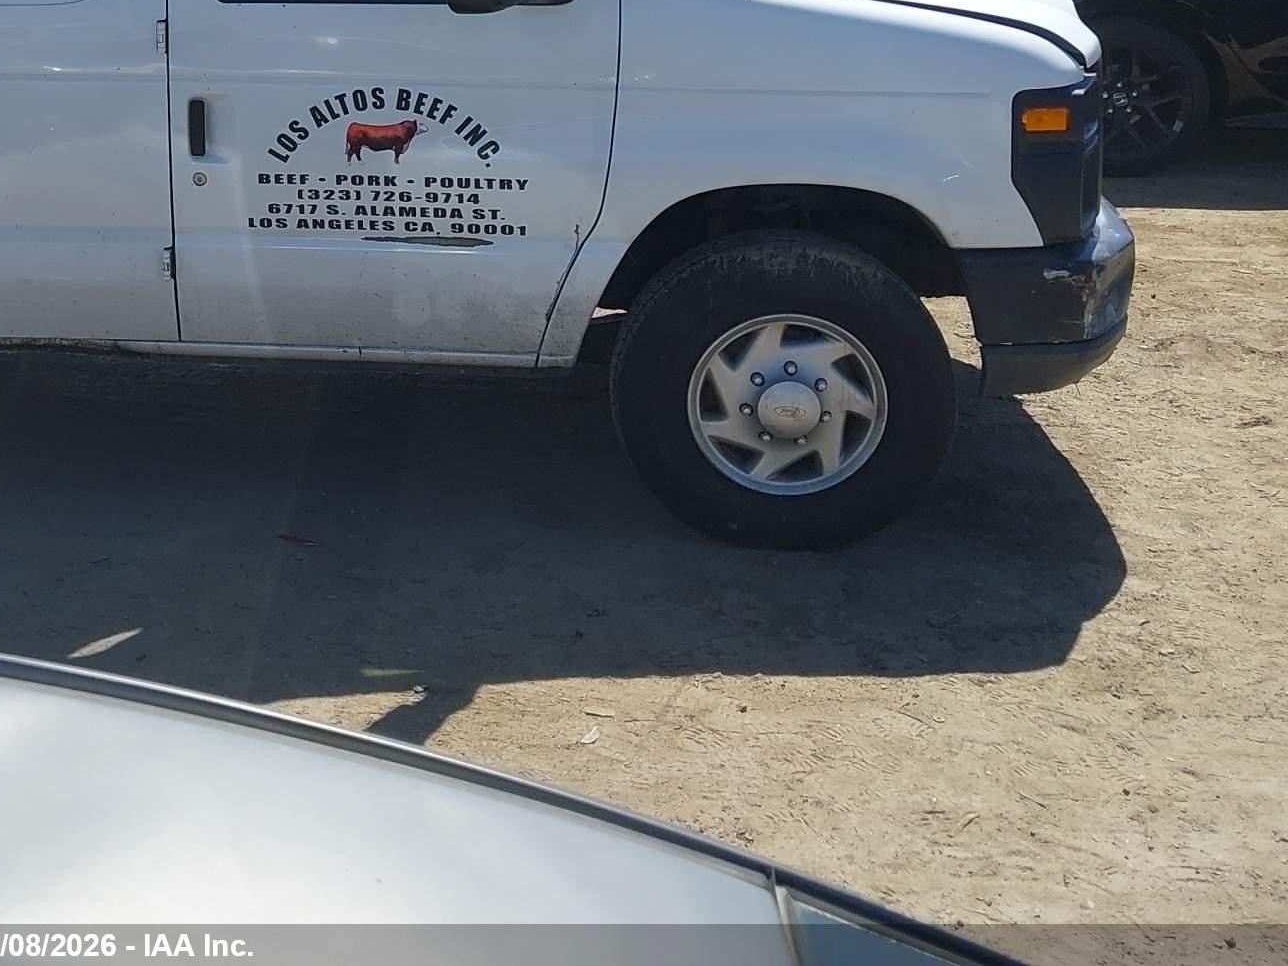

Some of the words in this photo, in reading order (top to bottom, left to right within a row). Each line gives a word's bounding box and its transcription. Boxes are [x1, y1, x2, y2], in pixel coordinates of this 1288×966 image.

[267, 120, 310, 163] LOS
[309, 87, 385, 128] ALTOS
[396, 88, 458, 124] BEEF
[454, 116, 500, 168] INC.
[258, 173, 310, 185] BEEF
[335, 174, 398, 187] PORK
[424, 176, 529, 191] POULTRY
[297, 188, 361, 201] (323)
[370, 190, 480, 205] 726-9714
[267, 203, 318, 215] 6717
[326, 204, 347, 216] S.
[354, 205, 464, 219] ALAMEDA
[472, 209, 506, 221] ST.
[248, 217, 288, 229] LOS
[296, 218, 396, 232] ANGELES
[450, 222, 527, 236] 90001
